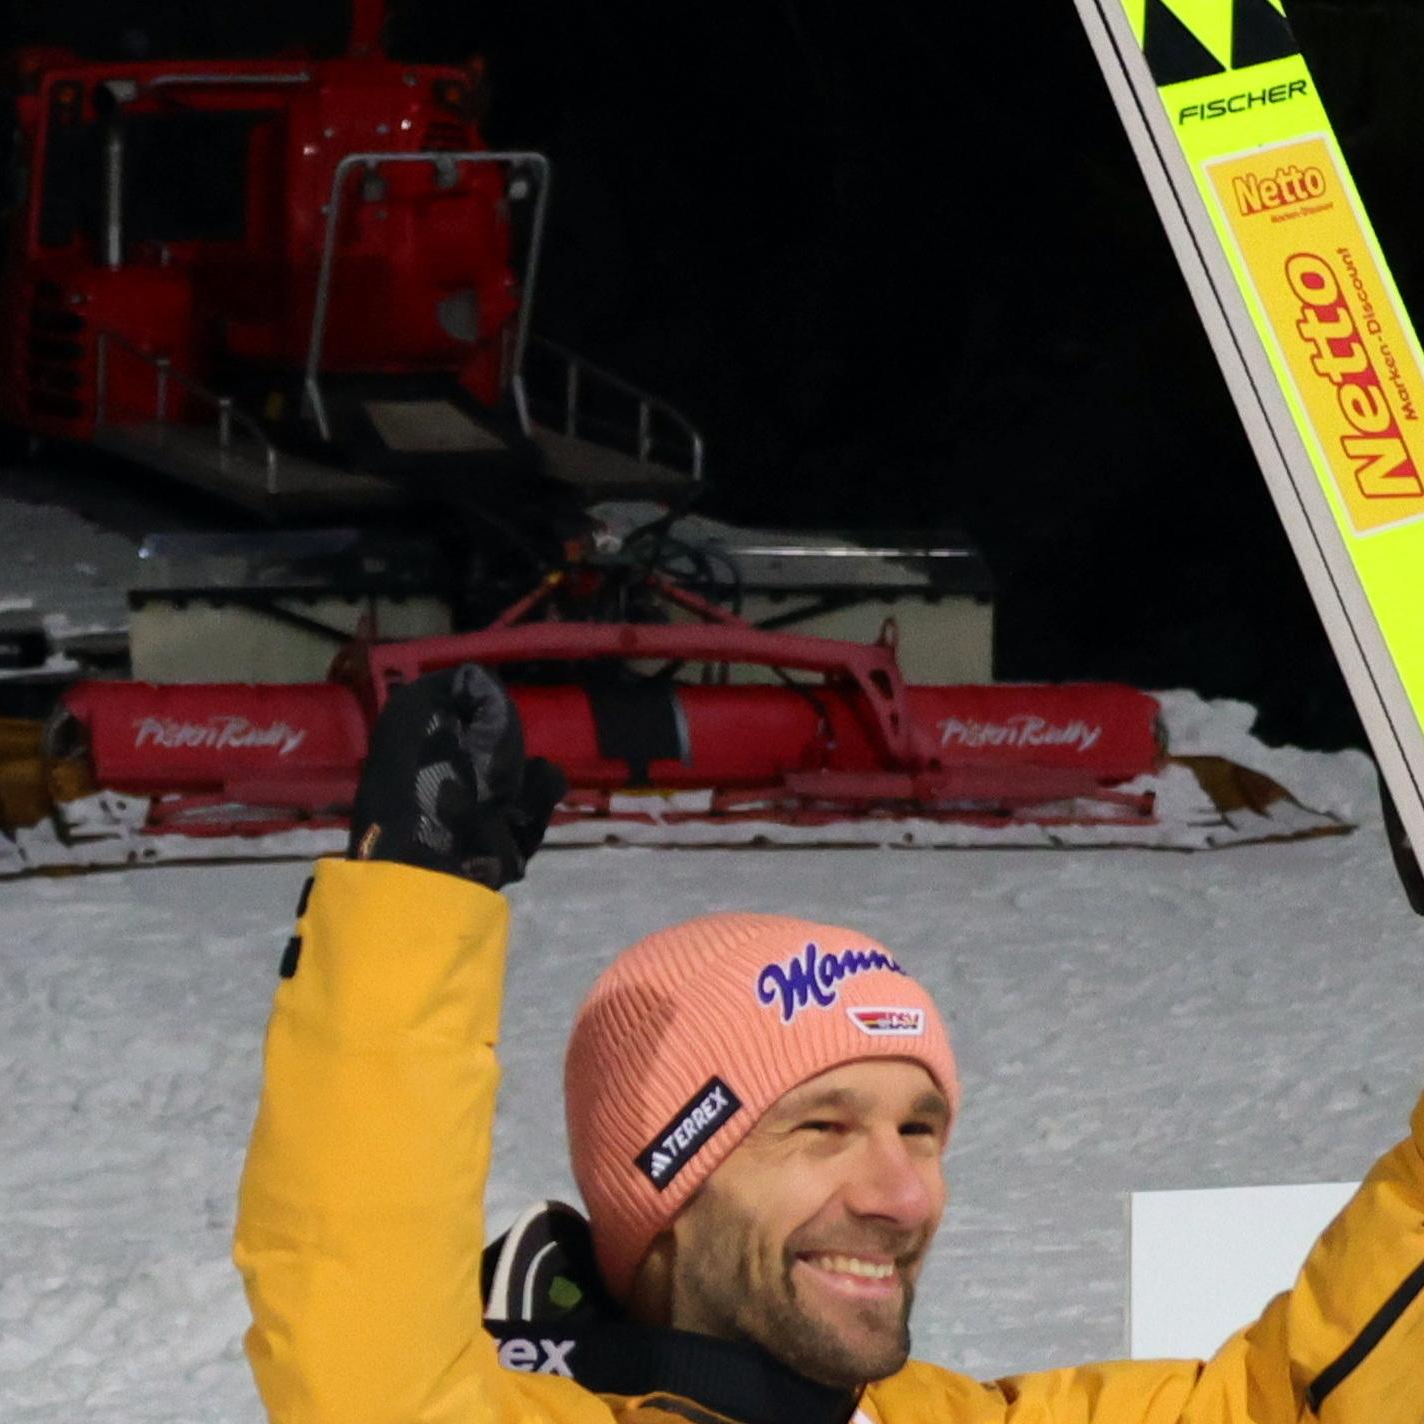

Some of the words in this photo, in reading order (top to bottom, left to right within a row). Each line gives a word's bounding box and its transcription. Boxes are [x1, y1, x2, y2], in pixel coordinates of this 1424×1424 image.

[1178, 79, 1308, 125] FISCHER
[1232, 165, 1326, 217] Netto
[1337, 247, 1419, 422] Marken-Discount
[1285, 252, 1424, 499] Netto
[758, 943, 907, 1021] Mann
[662, 1086, 729, 1158] TERREX
[493, 1338, 576, 1379] ex
